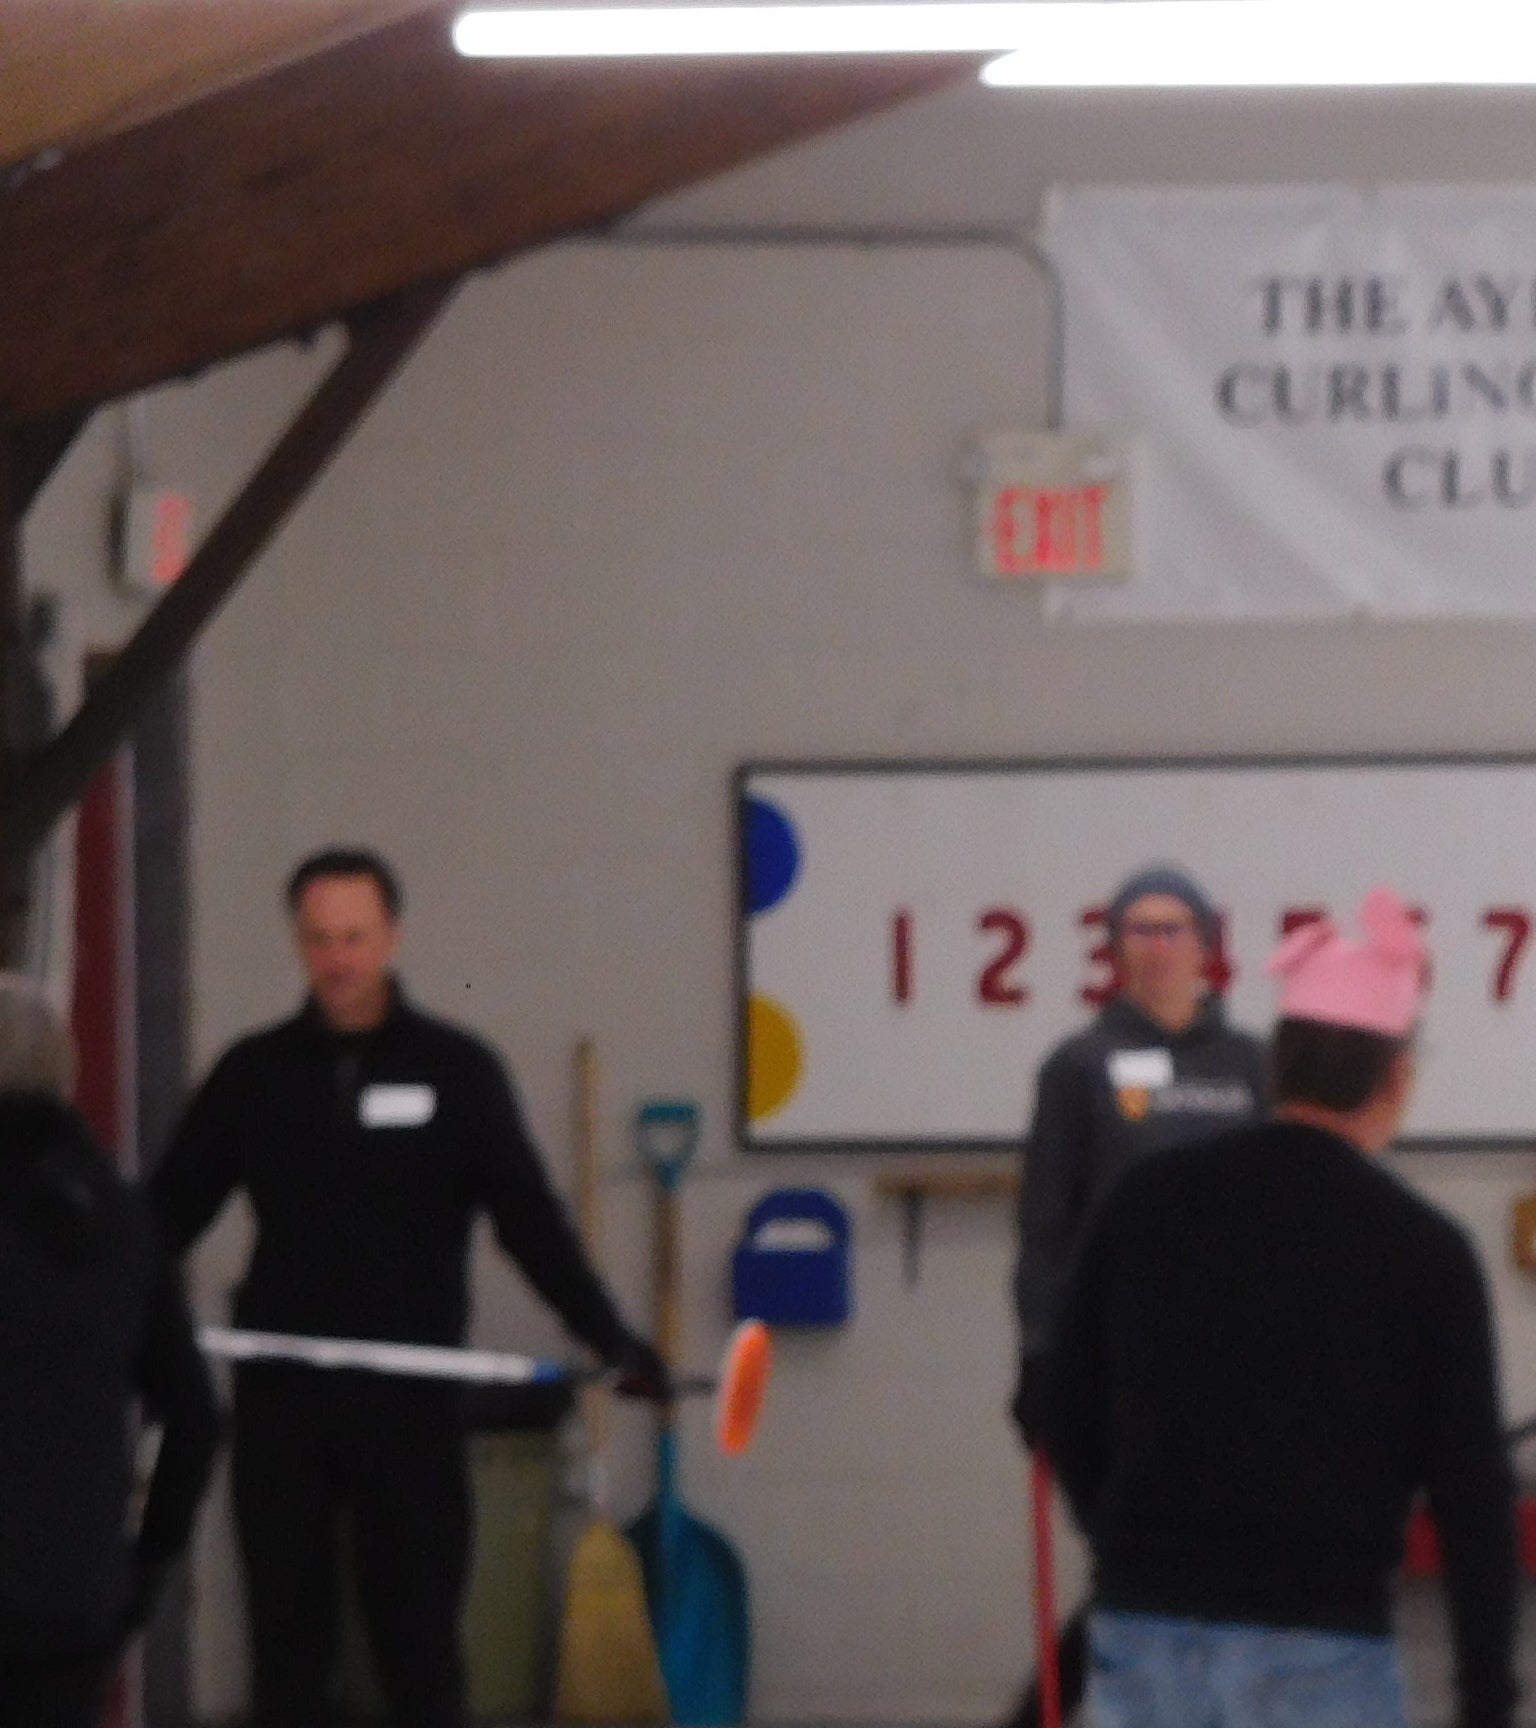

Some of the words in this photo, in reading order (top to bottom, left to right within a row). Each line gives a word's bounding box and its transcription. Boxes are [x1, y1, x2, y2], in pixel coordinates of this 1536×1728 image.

[1254, 272, 1404, 338] THE
[994, 484, 1108, 574] EXIT
[892, 911, 916, 1002] 1
[977, 910, 1030, 1006] 2
[1484, 908, 1536, 1001] 7
